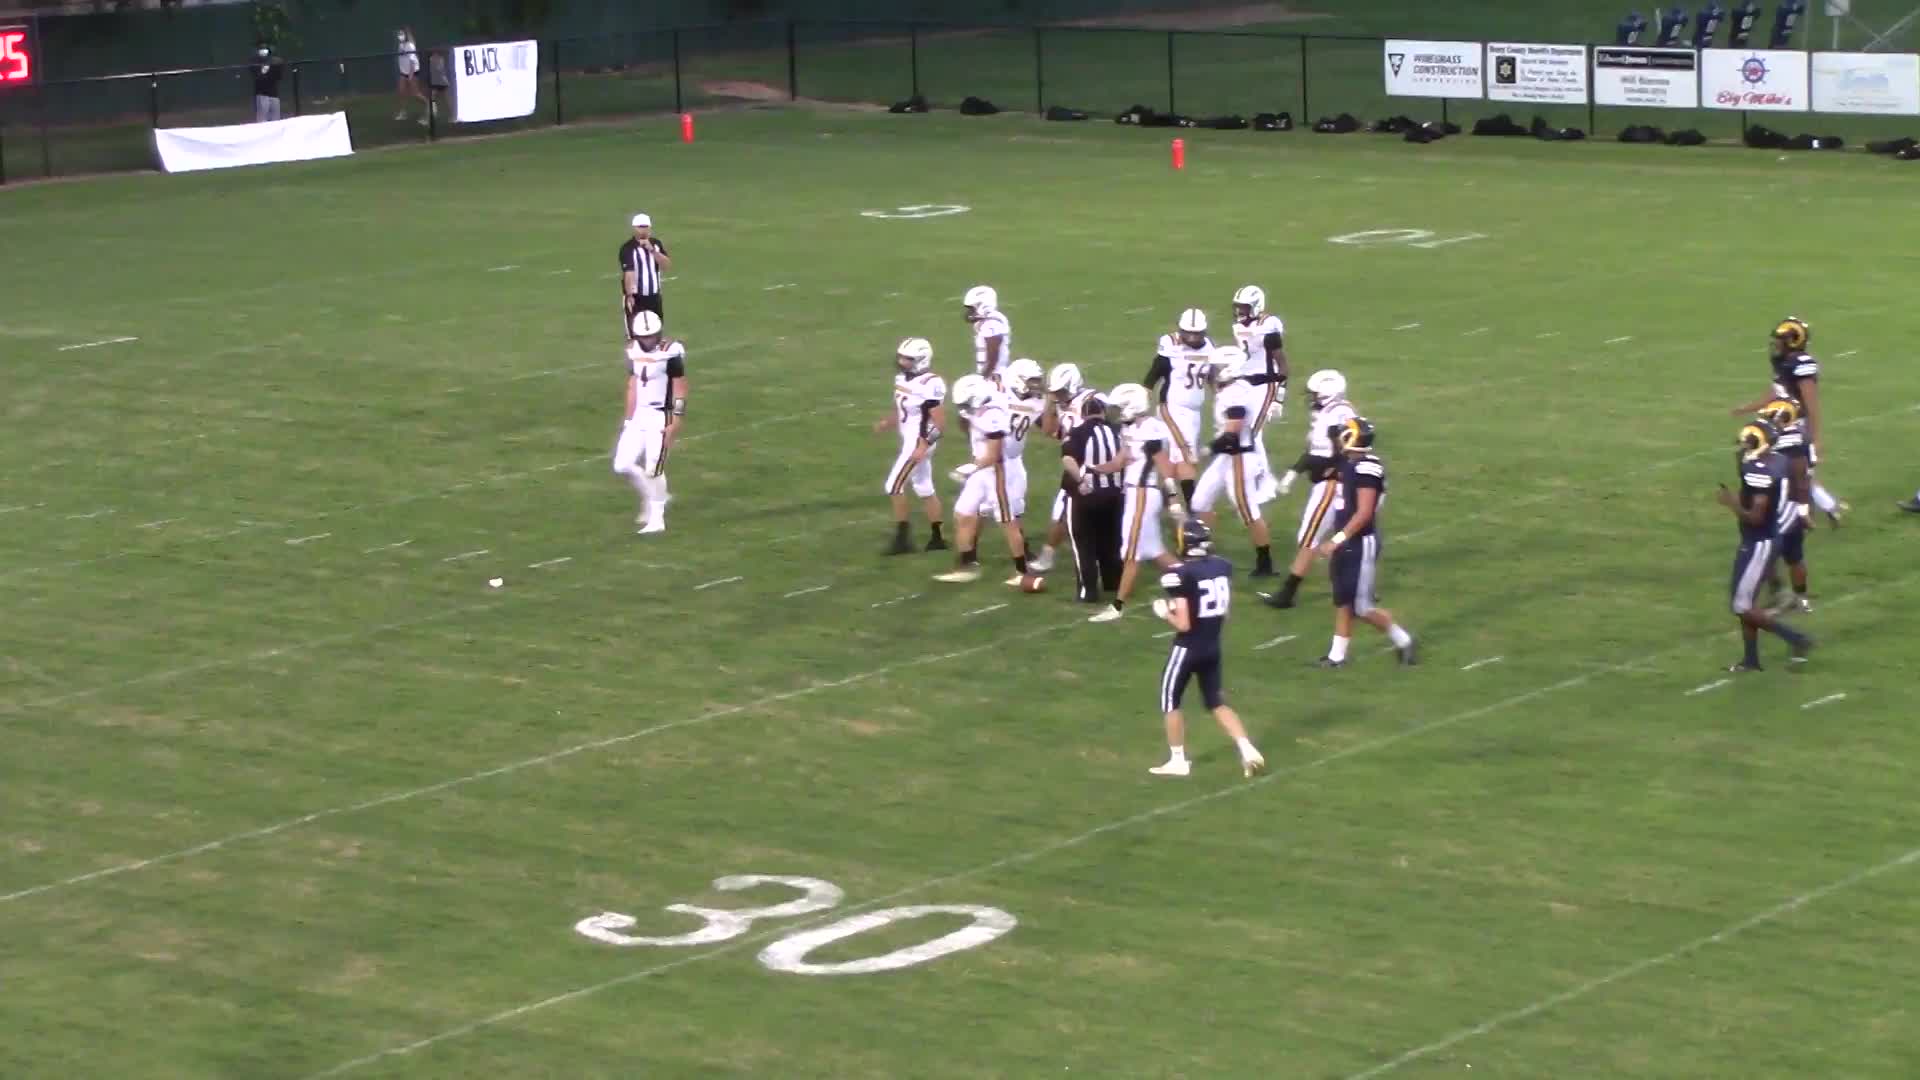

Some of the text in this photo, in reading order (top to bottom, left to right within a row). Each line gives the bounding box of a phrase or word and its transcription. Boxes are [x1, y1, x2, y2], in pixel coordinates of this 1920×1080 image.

[1413, 65, 1479, 76] CONSTRUCTION
[1197, 576, 1230, 618] 28
[574, 874, 1018, 976] 30
